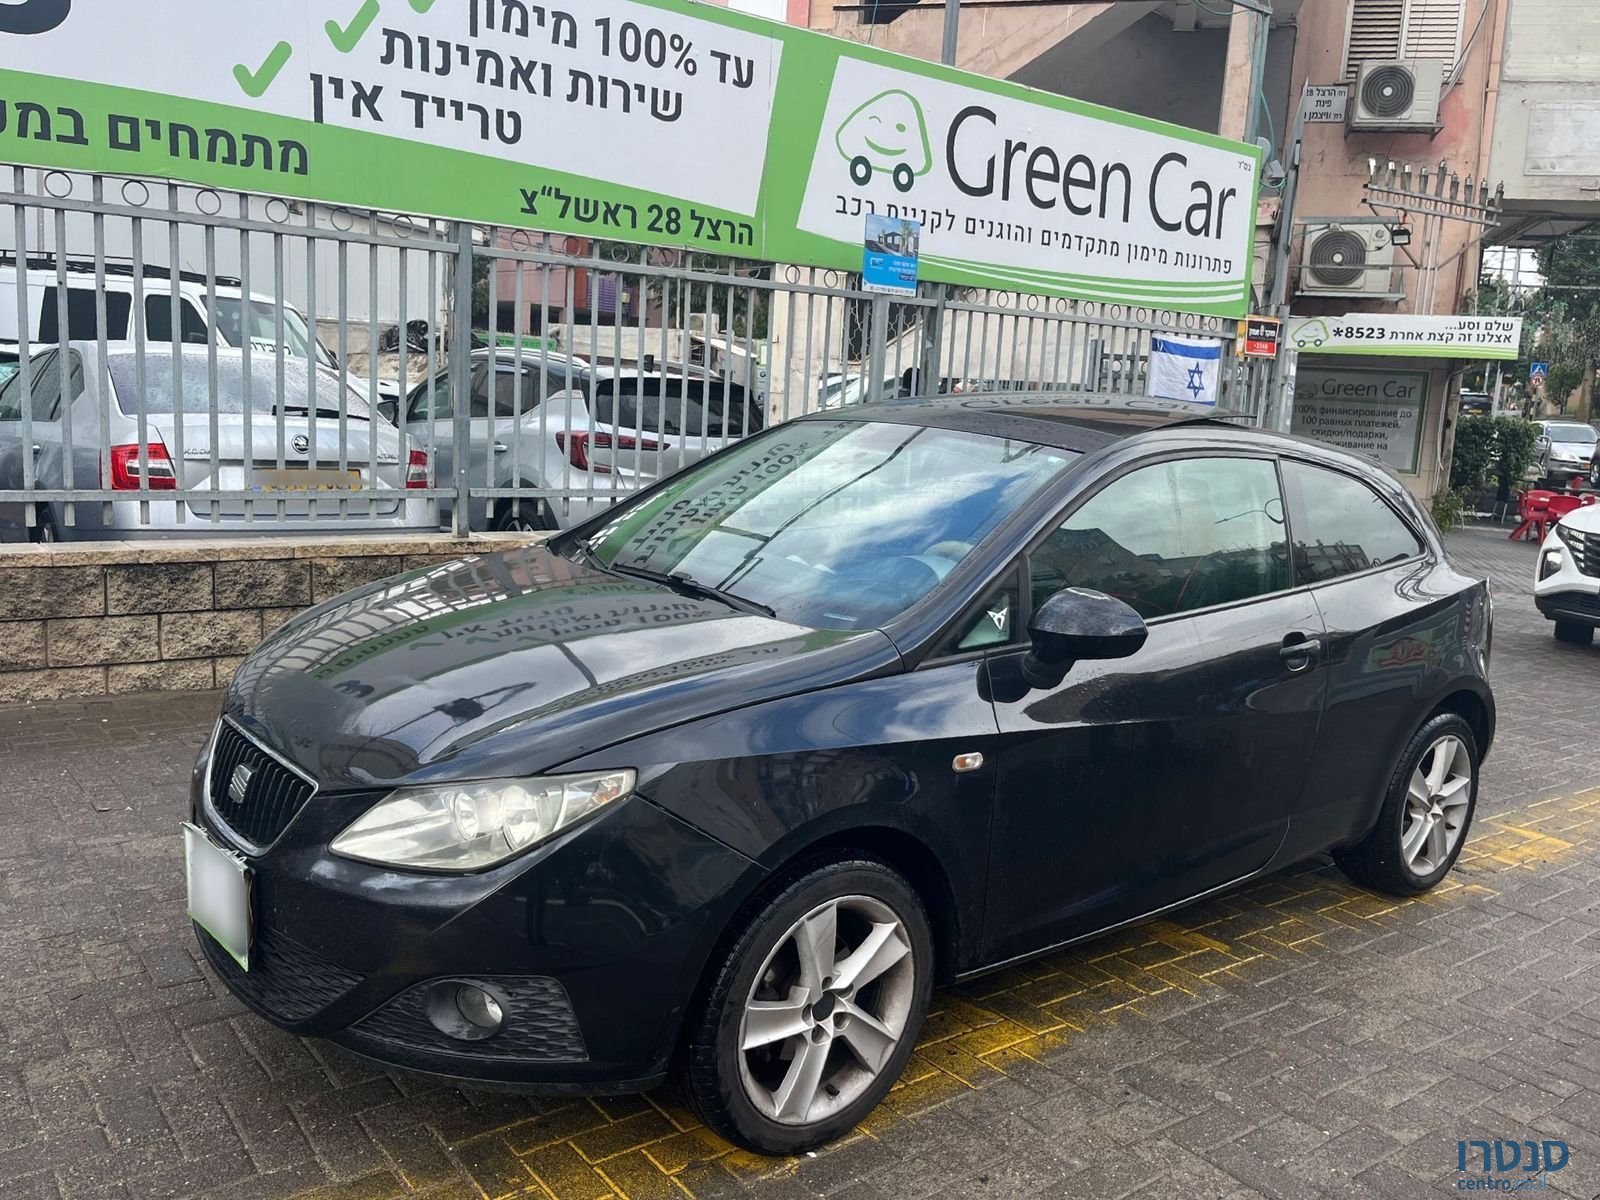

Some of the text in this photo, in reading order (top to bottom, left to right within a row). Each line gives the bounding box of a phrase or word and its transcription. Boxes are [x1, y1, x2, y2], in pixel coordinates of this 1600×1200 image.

[469, 0, 754, 88] עד 100% מימון
[380, 28, 682, 122] שירות ואמינות
[1316, 88, 1336, 96] הרצל
[310, 72, 521, 144] טרייד אין
[0, 100, 308, 176] מתמחים במ
[946, 105, 1236, 239] Green Car
[836, 195, 875, 216] רכב
[647, 204, 681, 235] 28
[690, 209, 752, 246] הרצל
[965, 217, 1032, 243] והוגנים
[1041, 229, 1120, 257] מתקדמים
[1127, 243, 1168, 264] מימון
[1174, 251, 1232, 274] פתרונות
[1389, 330, 1512, 344] אצלנו זה קצת אחרת
[1485, 320, 1513, 331] שלם
[1322, 378, 1416, 399] Green Car
[1302, 416, 1317, 425] 100
[1319, 418, 1352, 428] равных
[1319, 406, 1398, 418] финансирование
[1399, 410, 1412, 419] до
